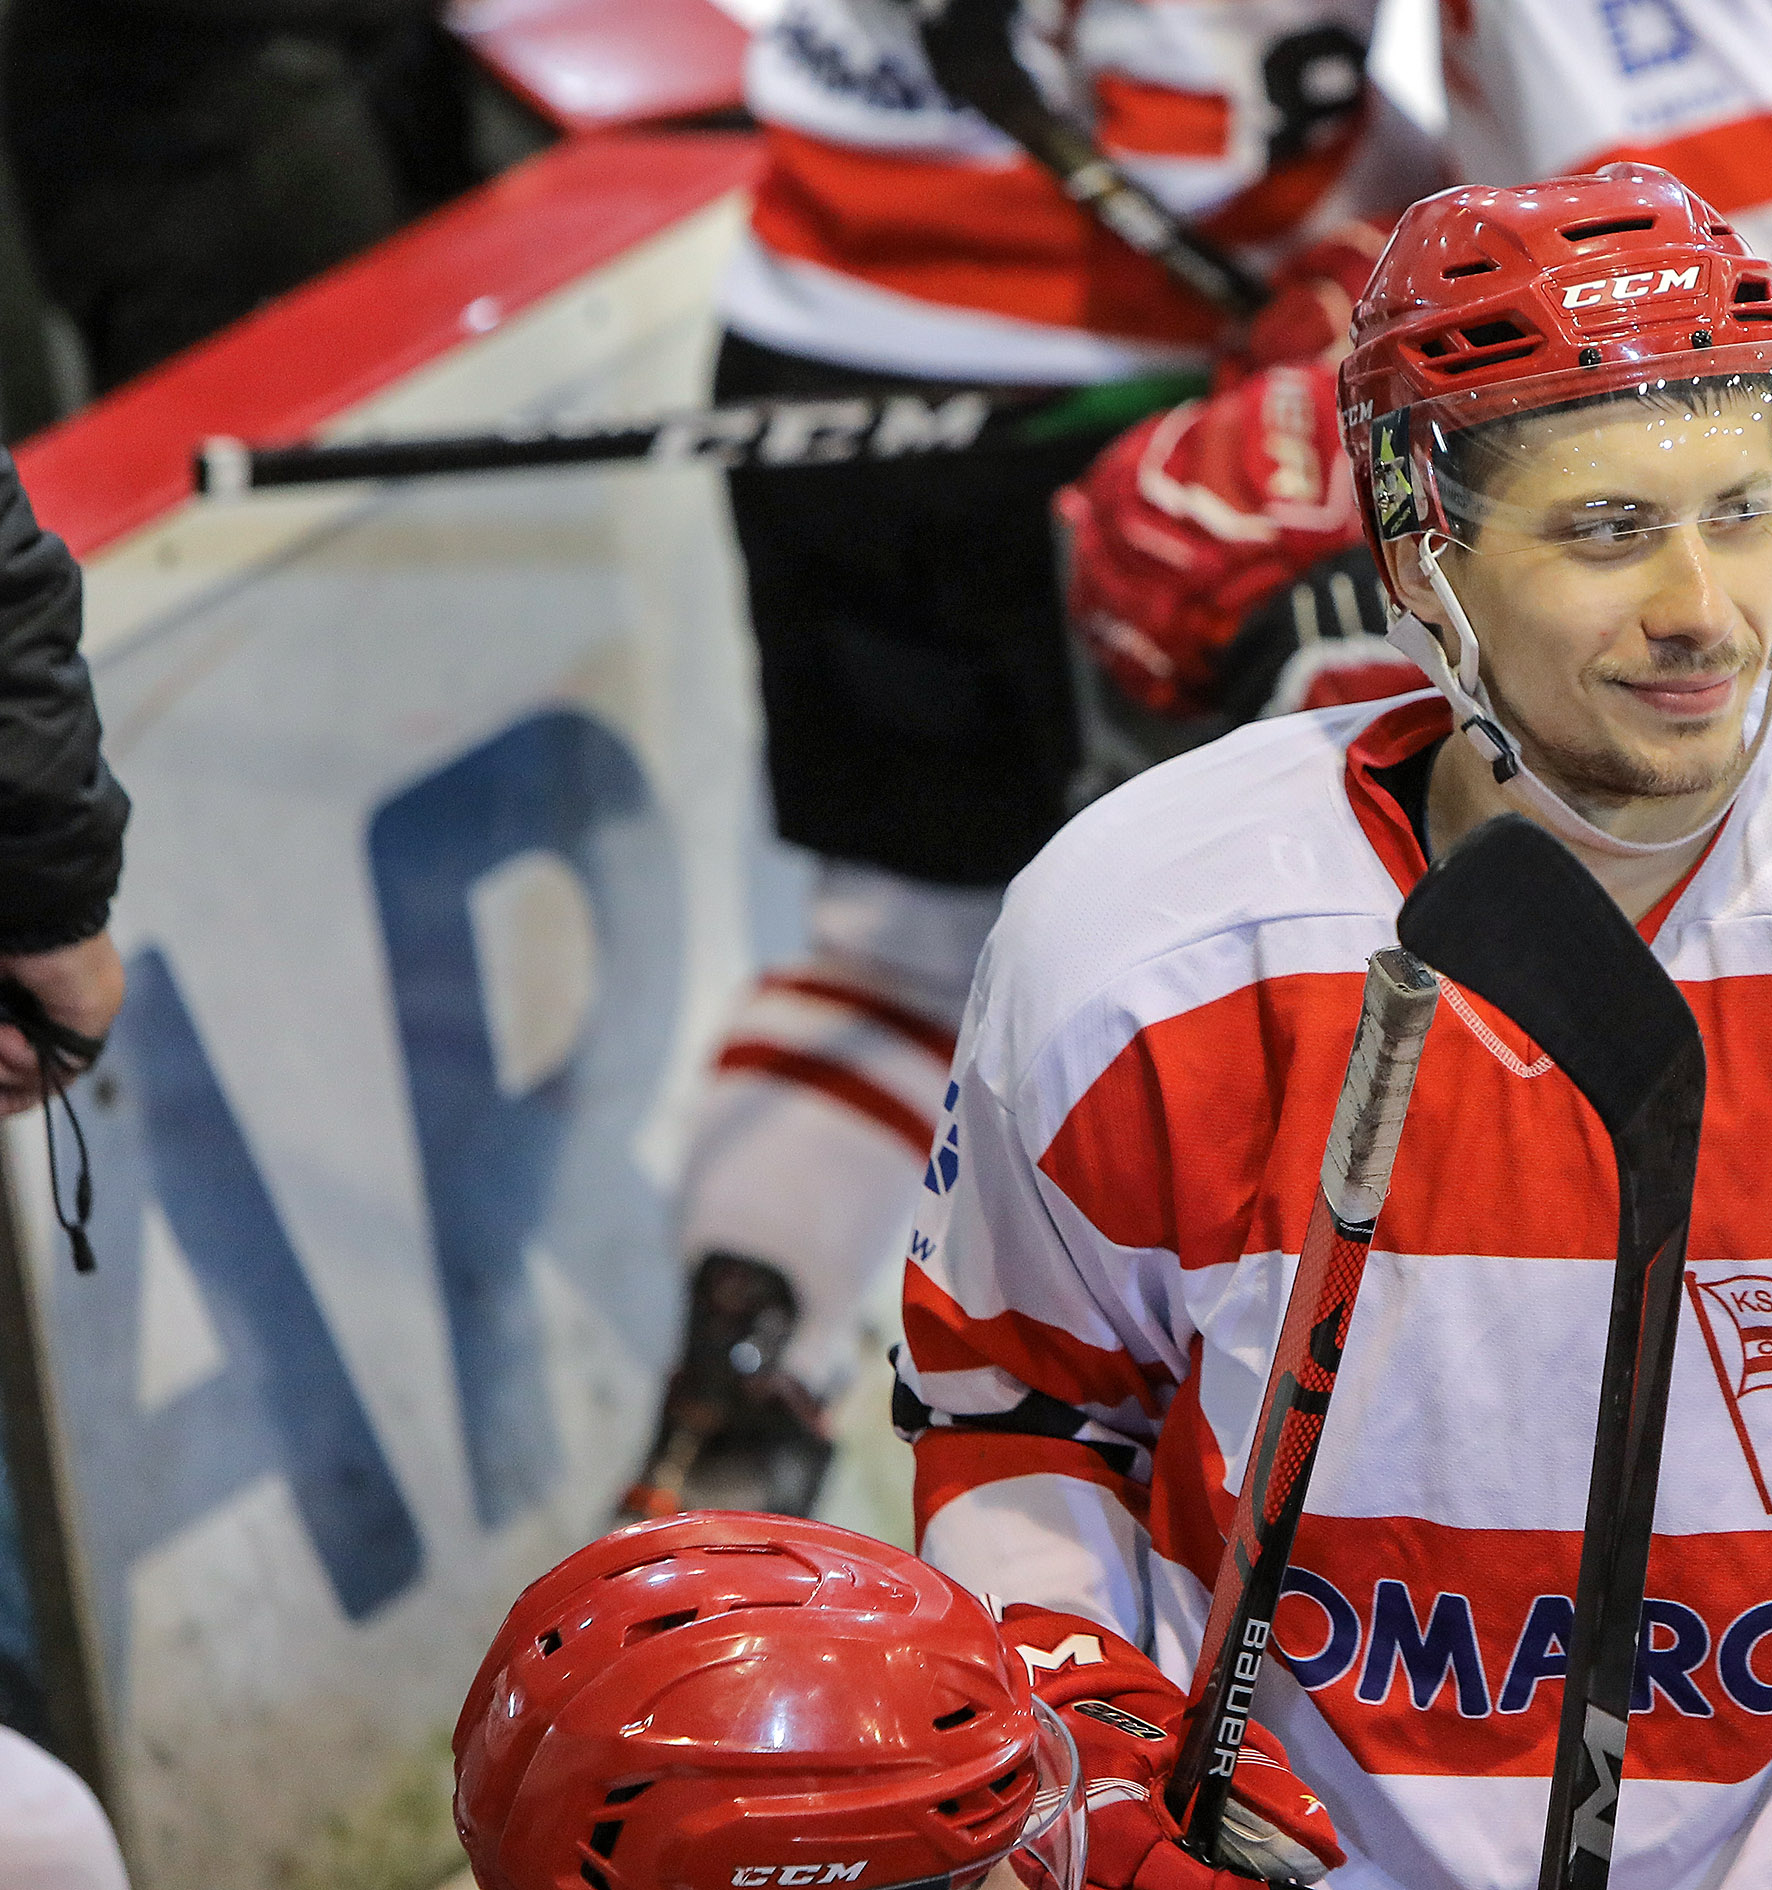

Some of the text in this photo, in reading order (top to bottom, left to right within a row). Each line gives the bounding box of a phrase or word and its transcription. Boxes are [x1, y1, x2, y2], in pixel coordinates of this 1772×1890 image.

[1562, 266, 1701, 309] CCM
[1208, 1618, 1270, 1778] BAUER
[731, 1860, 869, 1887] CCM
